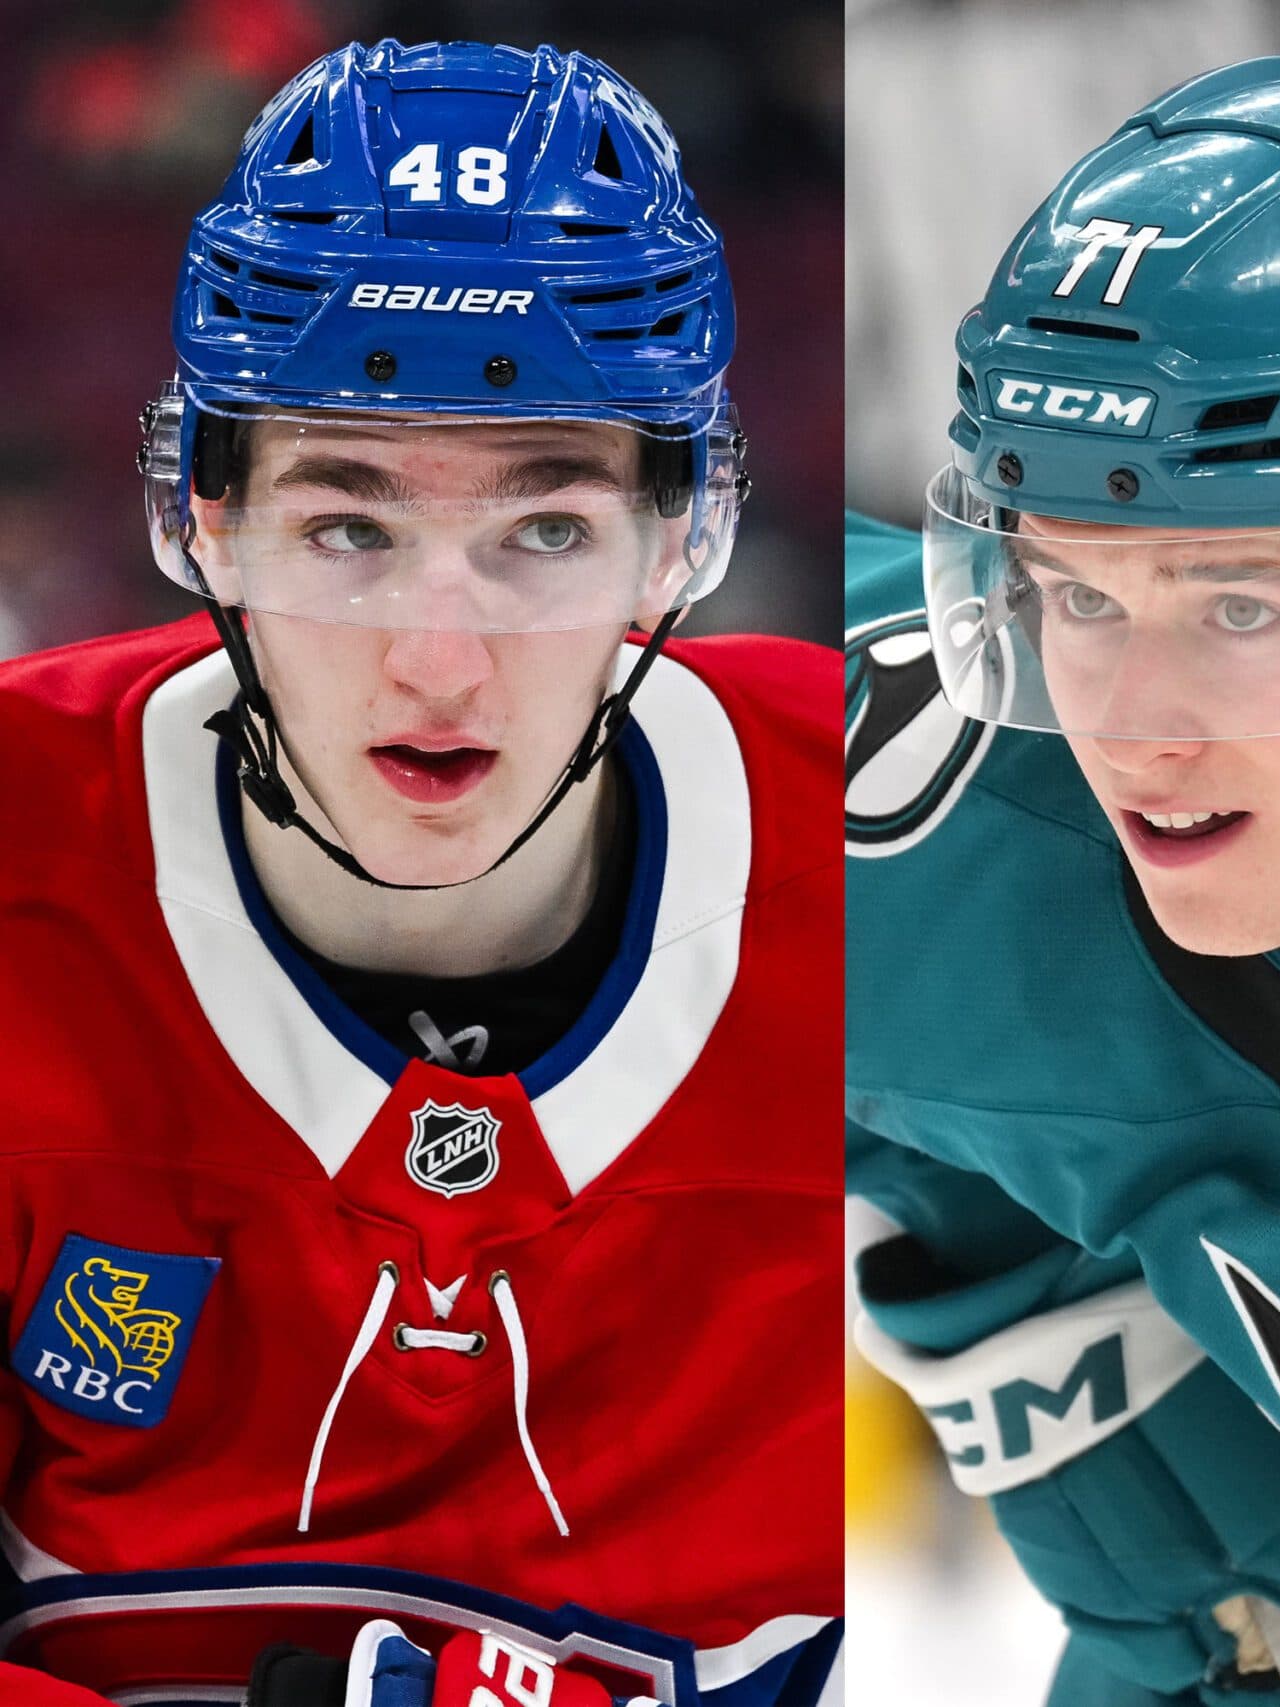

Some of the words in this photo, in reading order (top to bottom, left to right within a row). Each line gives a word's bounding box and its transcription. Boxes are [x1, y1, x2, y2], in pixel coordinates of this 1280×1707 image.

[388, 143, 508, 206] 48
[1051, 216, 1165, 306] 71
[996, 378, 1152, 427] CCM
[426, 1122, 483, 1174] LNH
[33, 1348, 152, 1414] RBC
